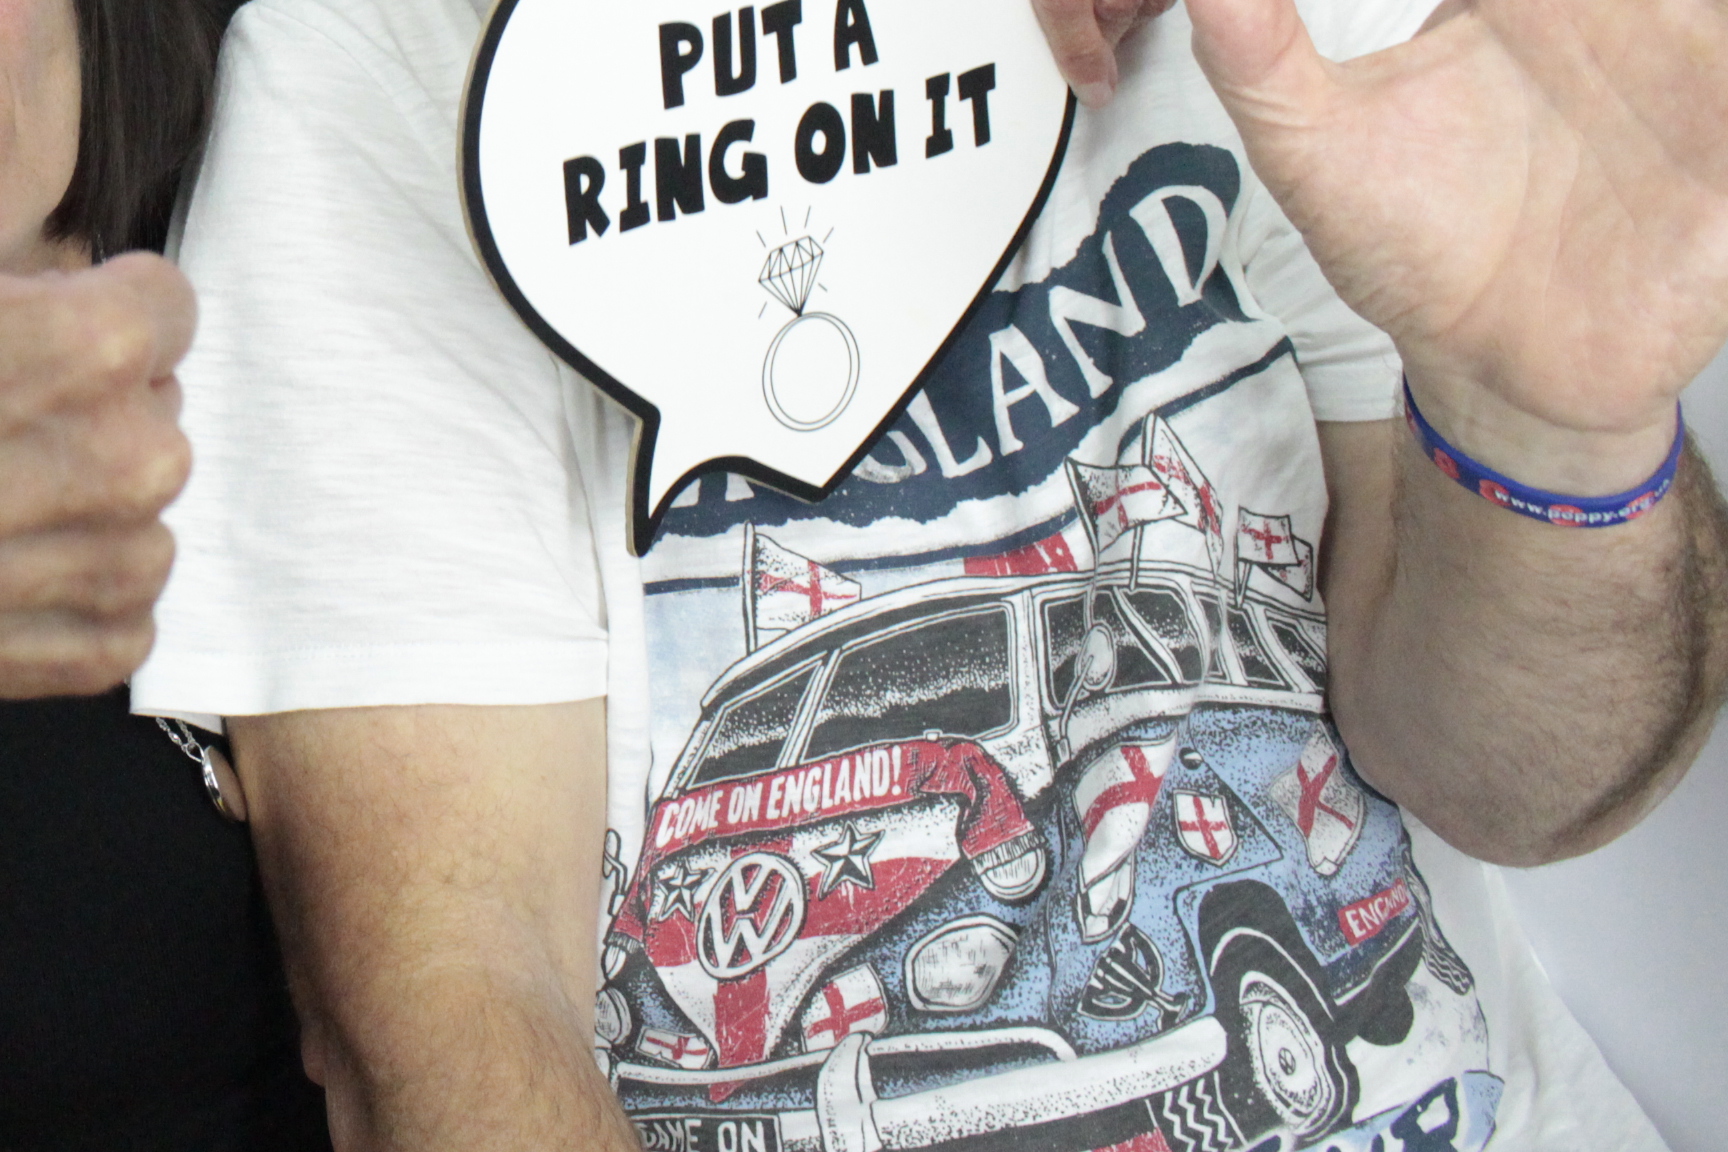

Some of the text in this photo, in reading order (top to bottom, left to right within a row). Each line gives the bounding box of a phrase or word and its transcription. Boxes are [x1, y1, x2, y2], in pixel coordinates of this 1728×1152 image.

[563, 62, 996, 246] RING ON IT
[655, 744, 902, 848] COME ON ENGLAND!
[717, 1120, 767, 1152] ON
